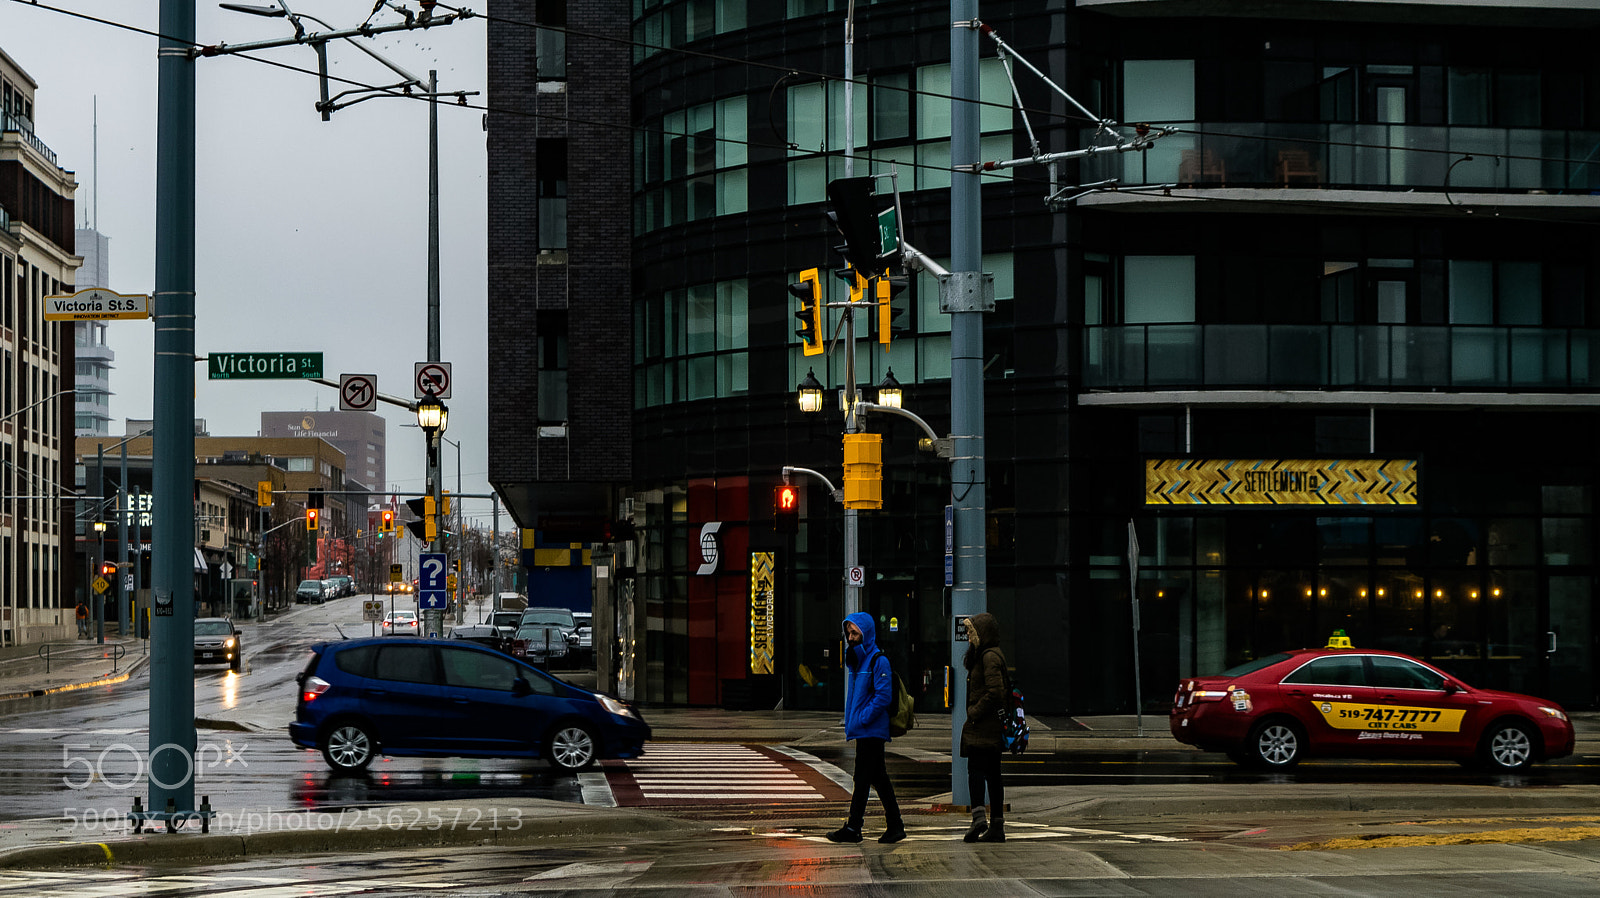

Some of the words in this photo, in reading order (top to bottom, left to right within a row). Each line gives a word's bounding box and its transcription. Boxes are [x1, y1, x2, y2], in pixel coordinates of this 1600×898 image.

[54, 300, 103, 312] Victoria
[217, 354, 297, 373] Victoria
[301, 358, 315, 368] St.
[1244, 471, 1308, 492] SETTLEMENT
[96, 581, 105, 589] 10
[755, 589, 768, 649] SETTLEMENT
[1339, 708, 1442, 723] 519-747-7777
[1358, 731, 1383, 740] Always
